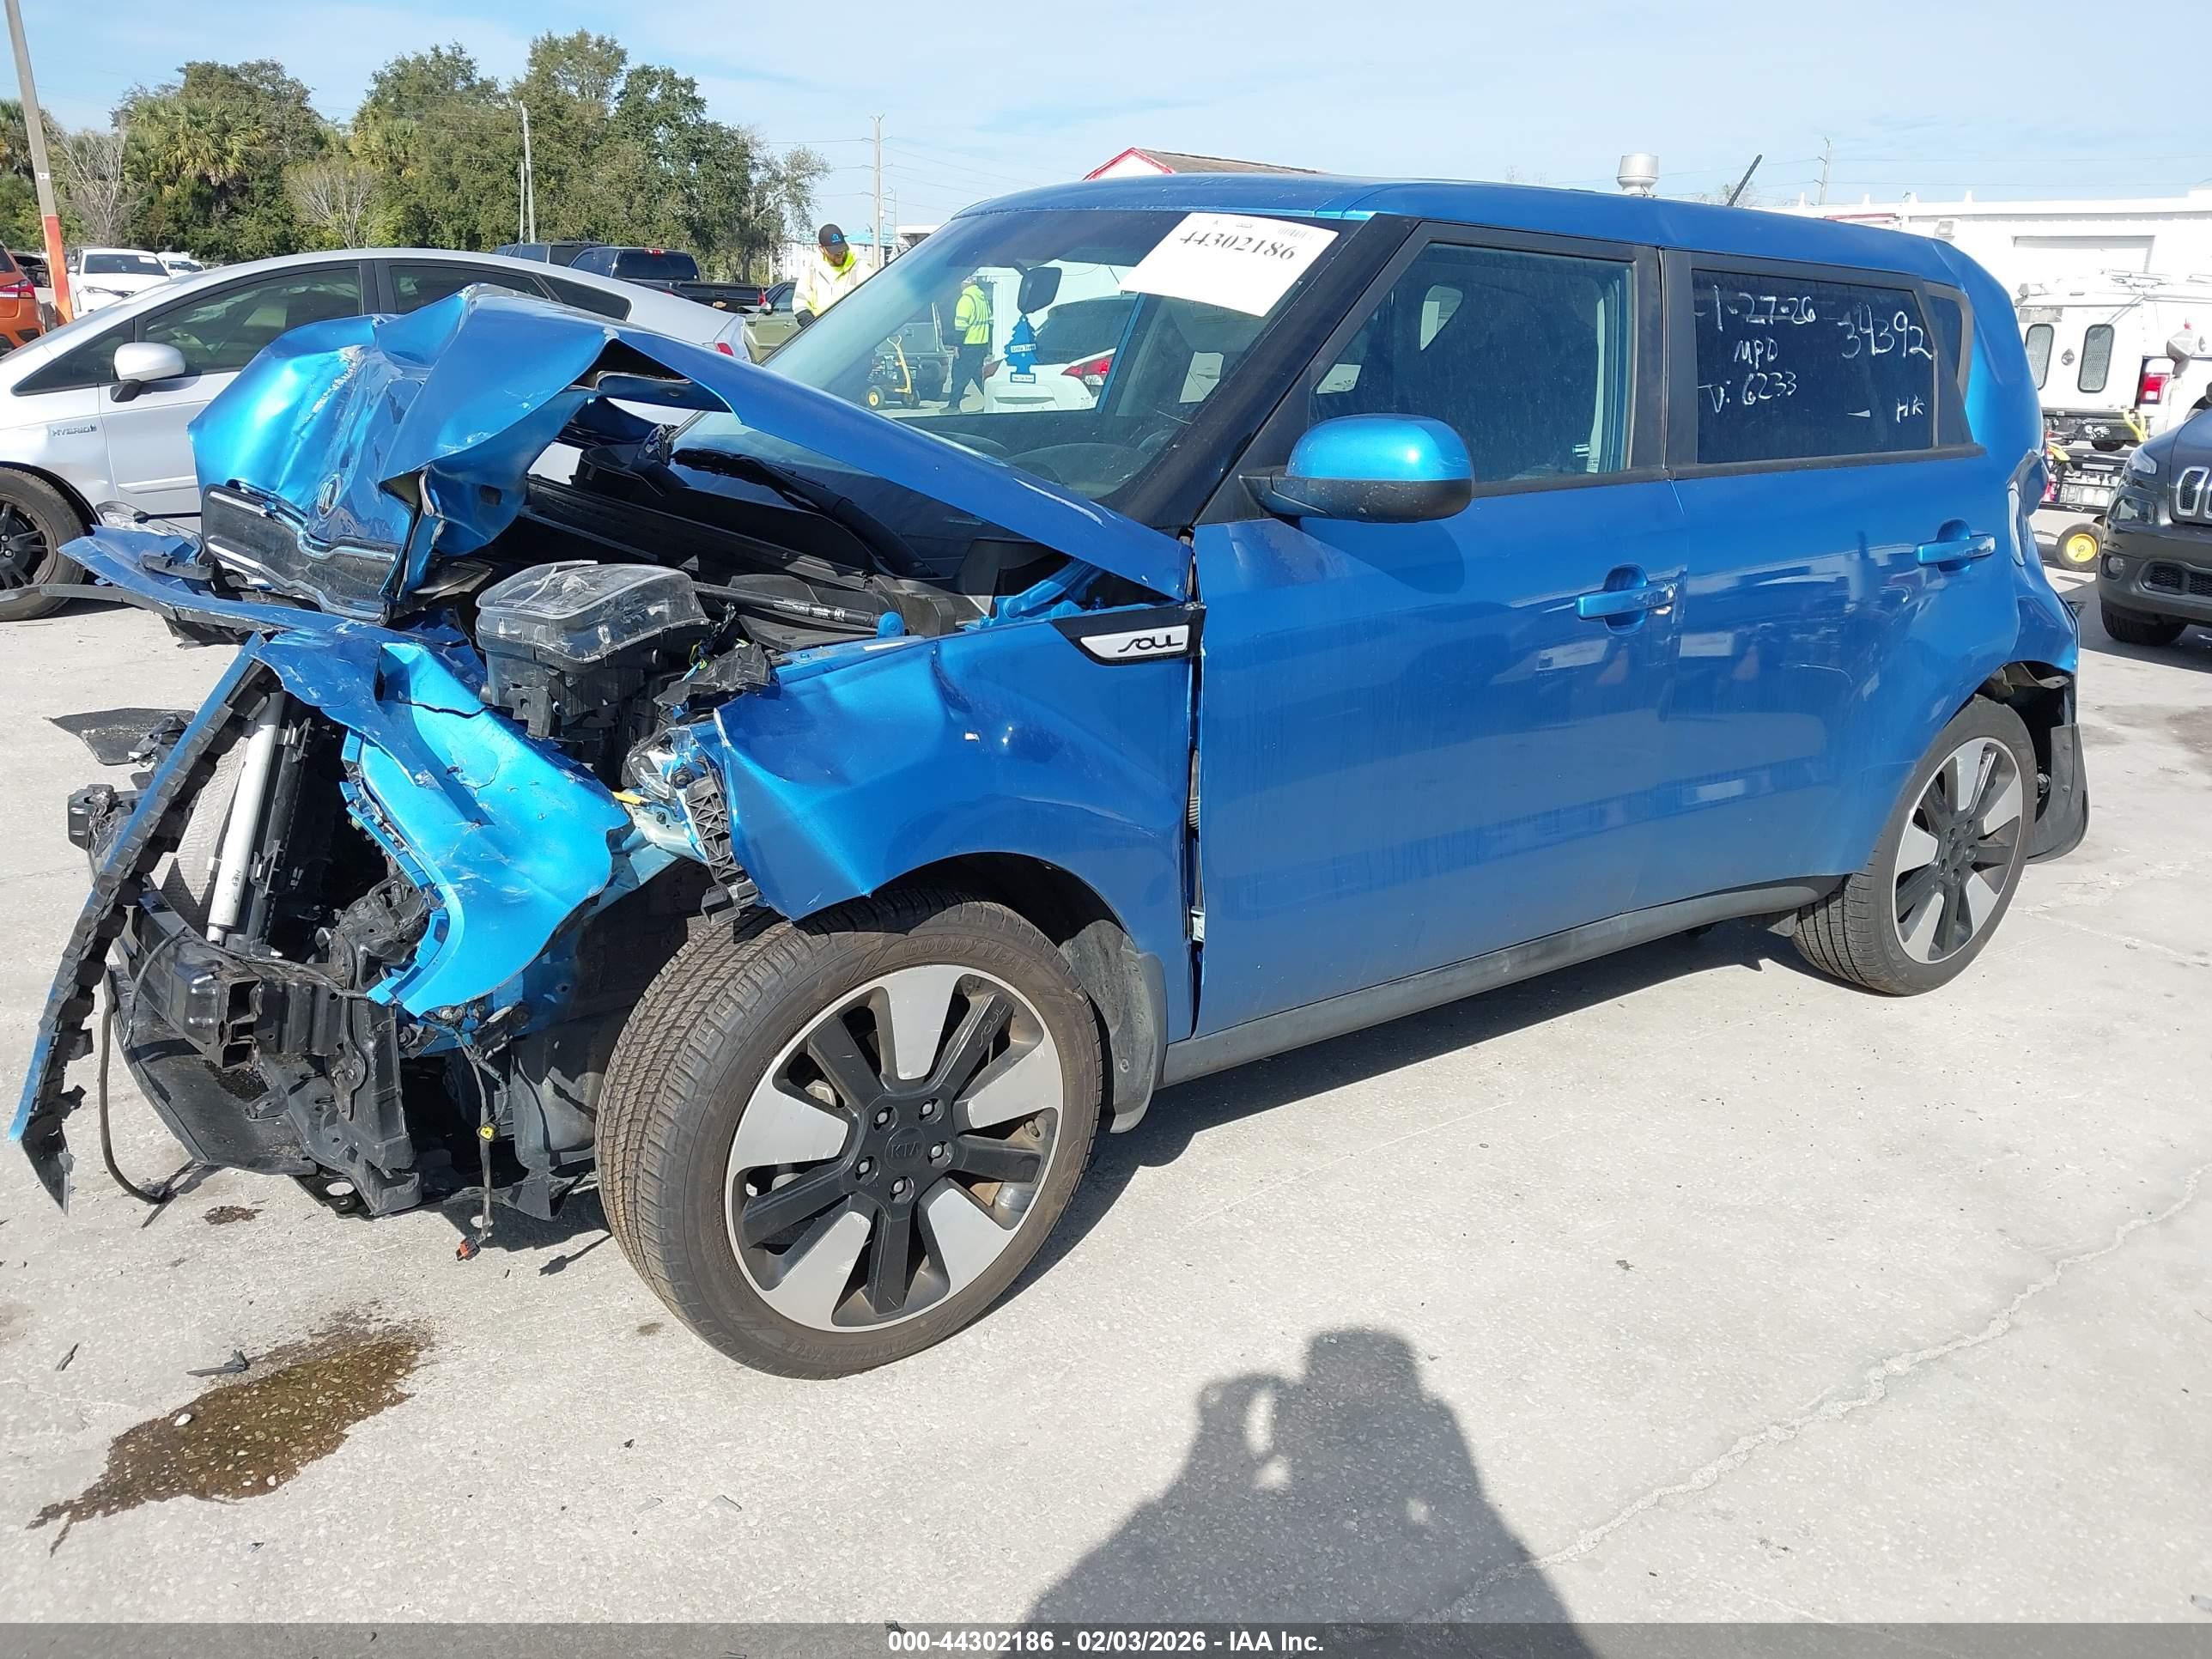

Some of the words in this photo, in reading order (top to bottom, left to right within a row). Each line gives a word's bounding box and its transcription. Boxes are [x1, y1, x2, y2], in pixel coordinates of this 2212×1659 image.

[1180, 231, 1296, 261] 44302186
[1837, 302, 1933, 360] 34392
[1741, 371, 1797, 405] 6233
[1117, 635, 1183, 653] SOUL
